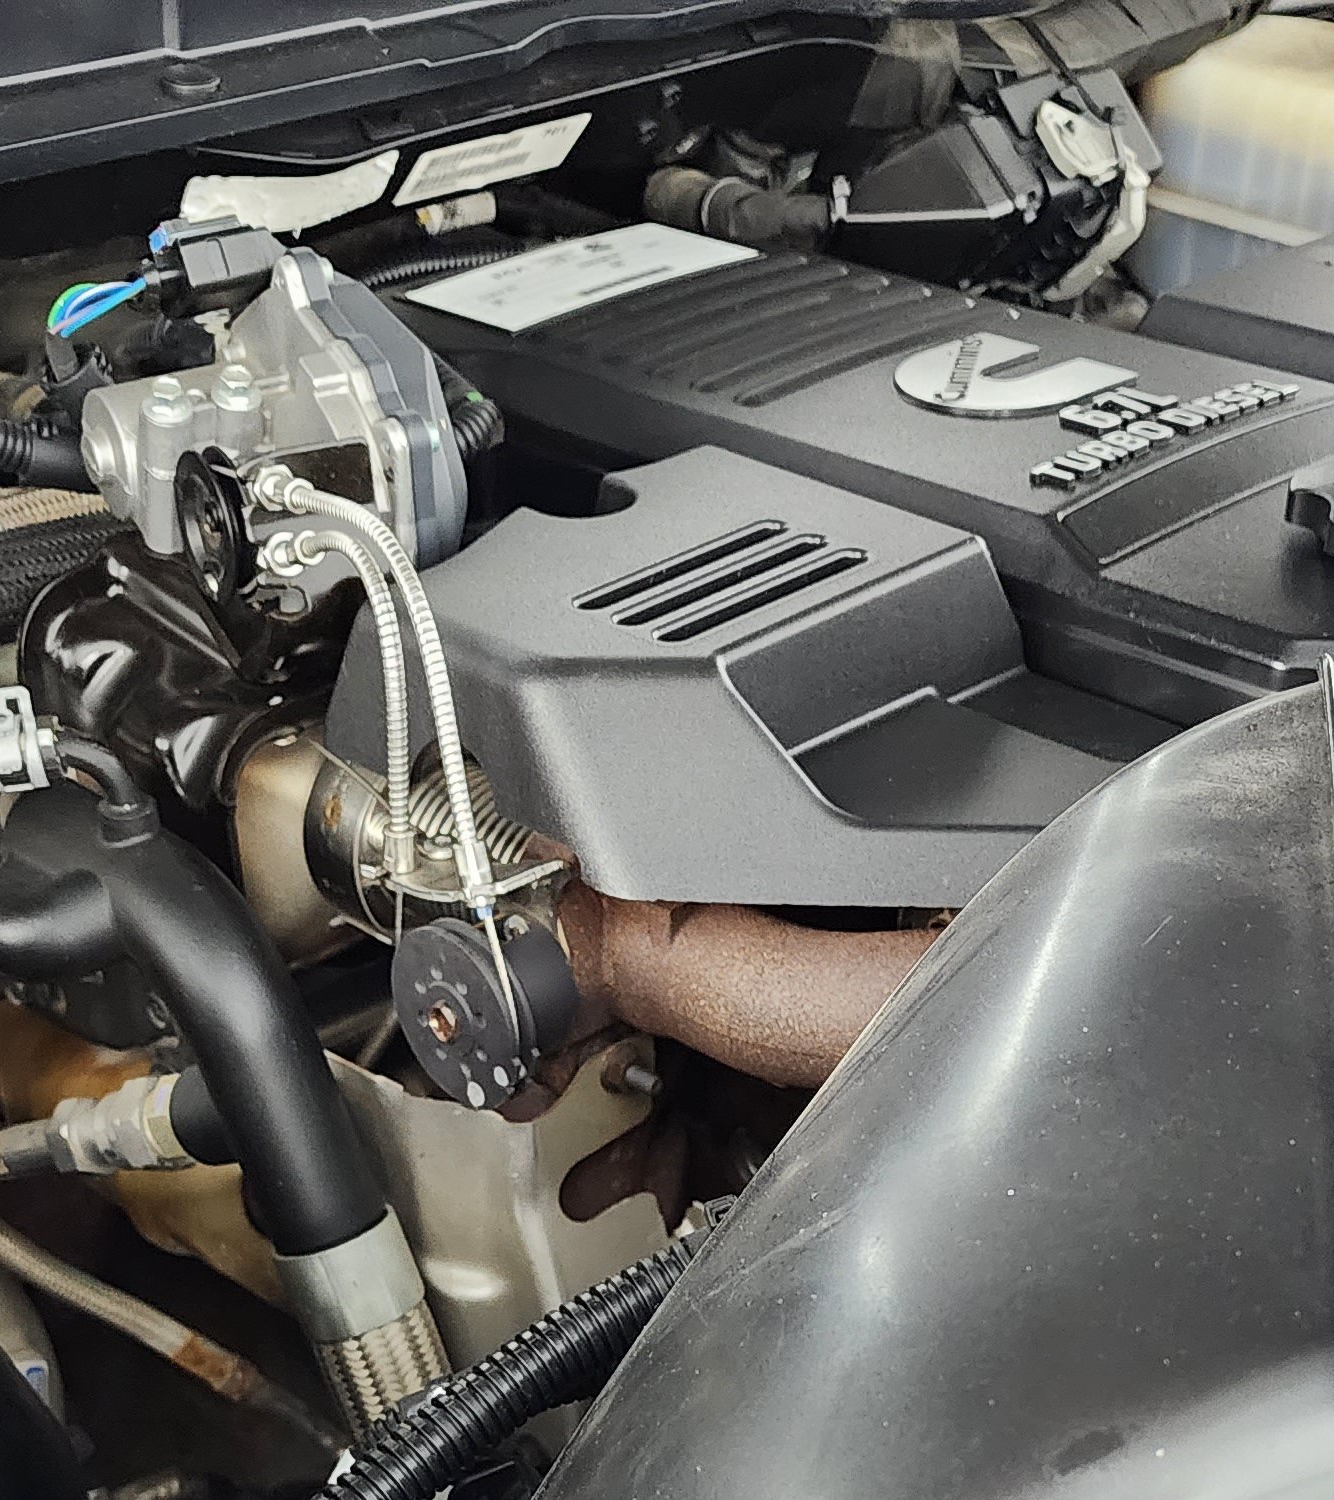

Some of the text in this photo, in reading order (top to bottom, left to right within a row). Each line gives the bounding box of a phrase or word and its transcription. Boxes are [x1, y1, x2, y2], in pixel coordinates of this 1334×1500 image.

[1029, 379, 1301, 490] TURBO DIESEL
[1058, 386, 1179, 437] 6.7L
